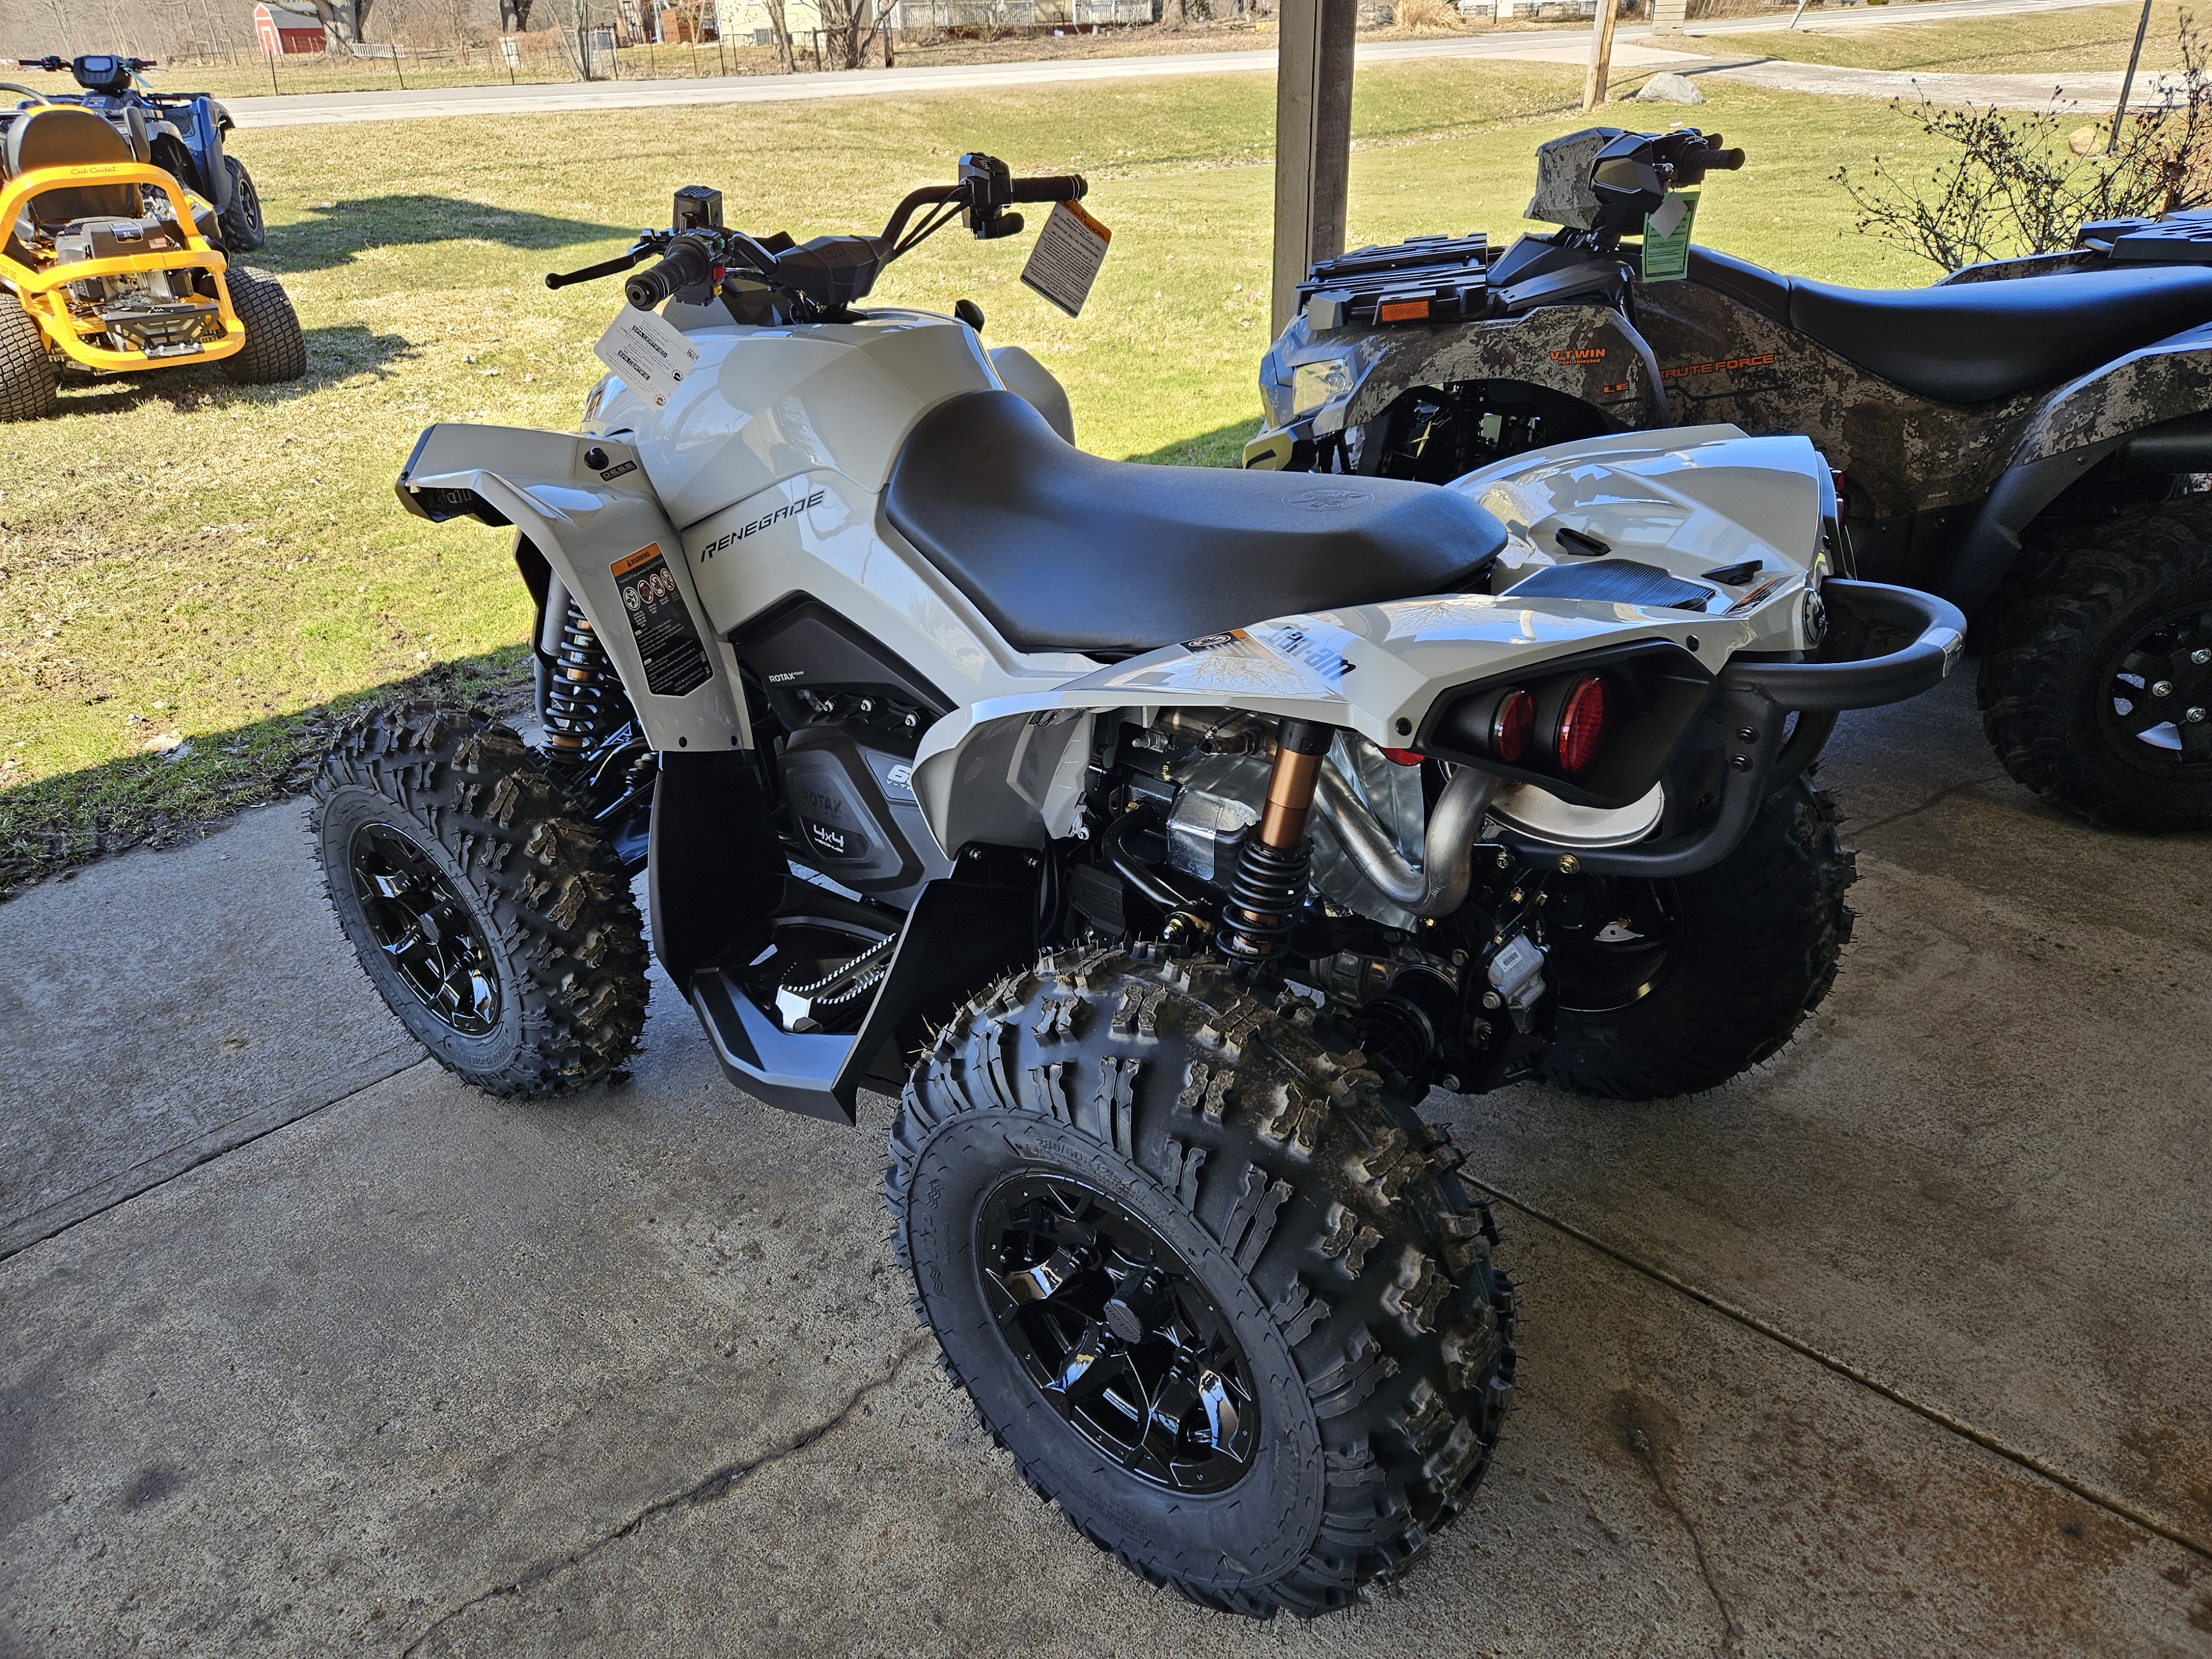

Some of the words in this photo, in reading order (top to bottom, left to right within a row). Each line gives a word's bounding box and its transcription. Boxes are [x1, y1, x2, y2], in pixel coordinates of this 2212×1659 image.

[1064, 200, 1083, 220] SPORT
[1084, 220, 1105, 240] MODEL
[632, 326, 644, 337] EPA
[641, 333, 667, 357] CERTIFIED
[618, 351, 629, 362] EPA
[1550, 348, 1605, 360] V-TWIN
[1659, 363, 1713, 380] BRUTE
[1715, 354, 1774, 370] FORCE
[1604, 383, 1629, 393] LE
[701, 490, 825, 563] RENEGADE
[631, 551, 651, 565] WARNING
[768, 672, 796, 682] ROTAX
[888, 764, 912, 785] 6
[886, 779, 912, 791] V-TW
[813, 824, 844, 847] 4x4
